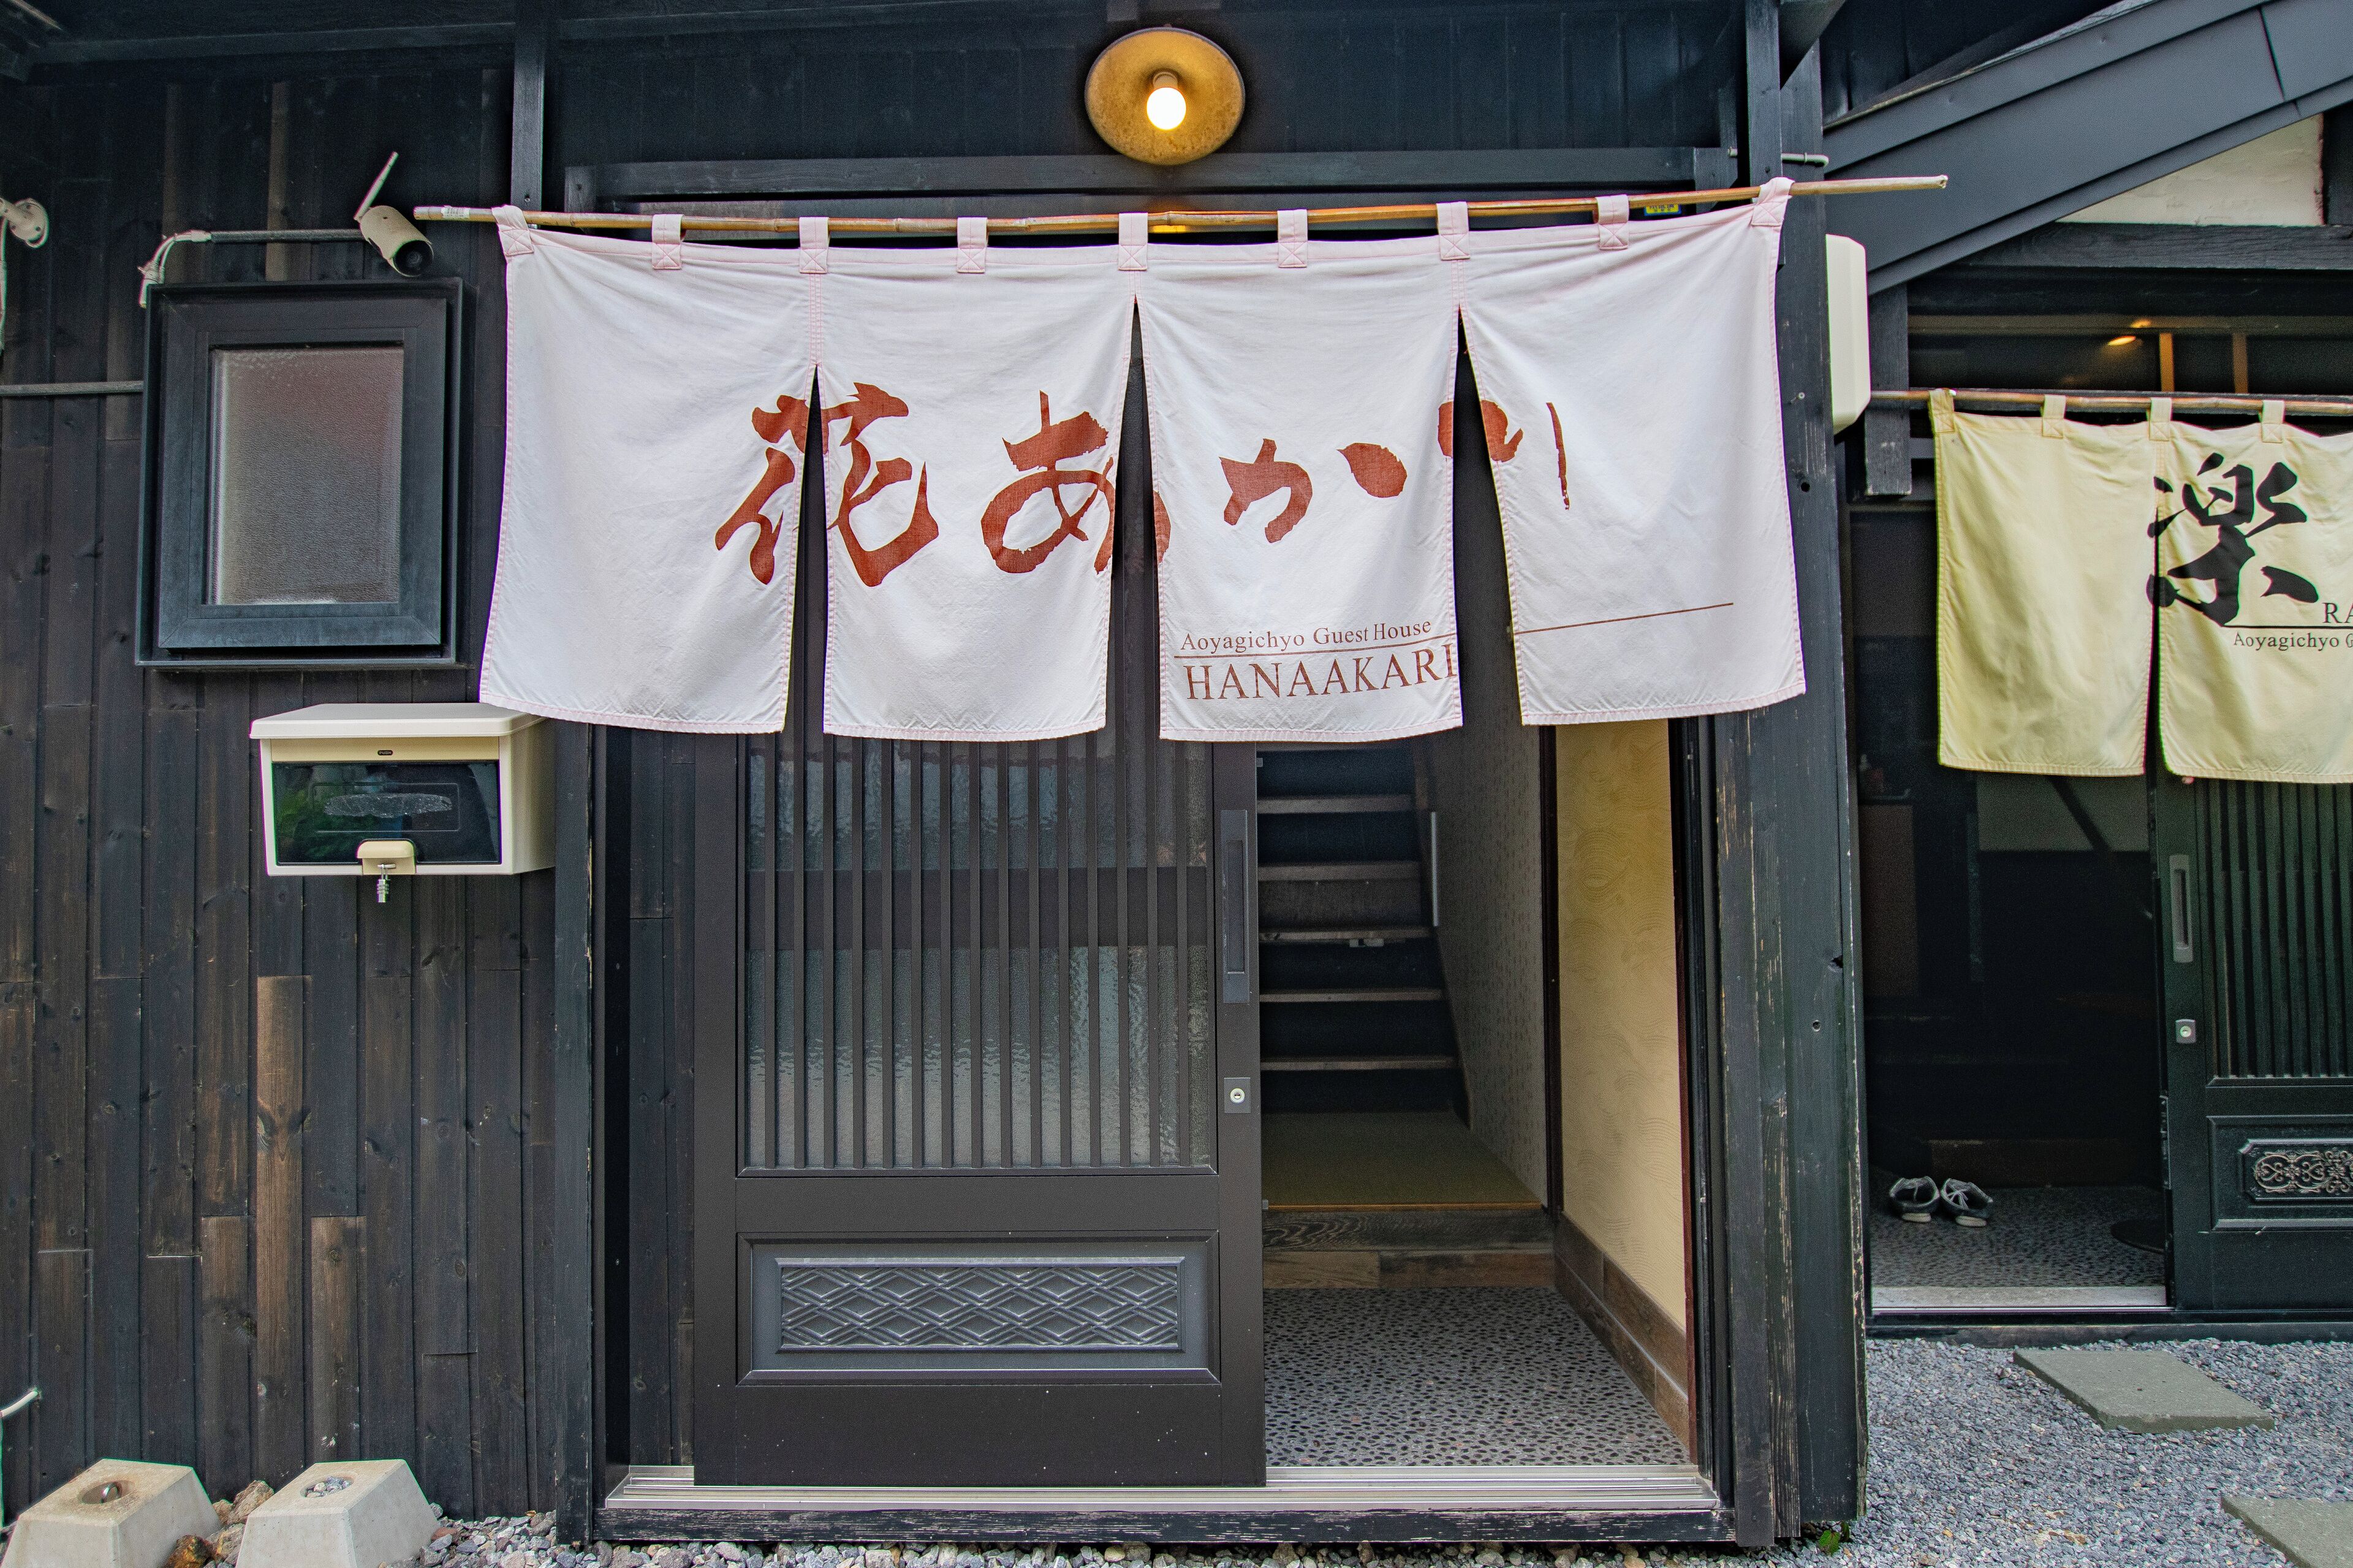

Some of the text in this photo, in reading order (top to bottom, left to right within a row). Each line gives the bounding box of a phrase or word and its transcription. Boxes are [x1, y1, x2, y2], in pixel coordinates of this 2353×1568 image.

[714, 382, 1570, 587] 花あかり
[1180, 620, 1431, 654] Aoyagichyo Guest House
[2234, 632, 2339, 651] Aoyagichyo
[1183, 643, 1457, 700] HANAAKARI
